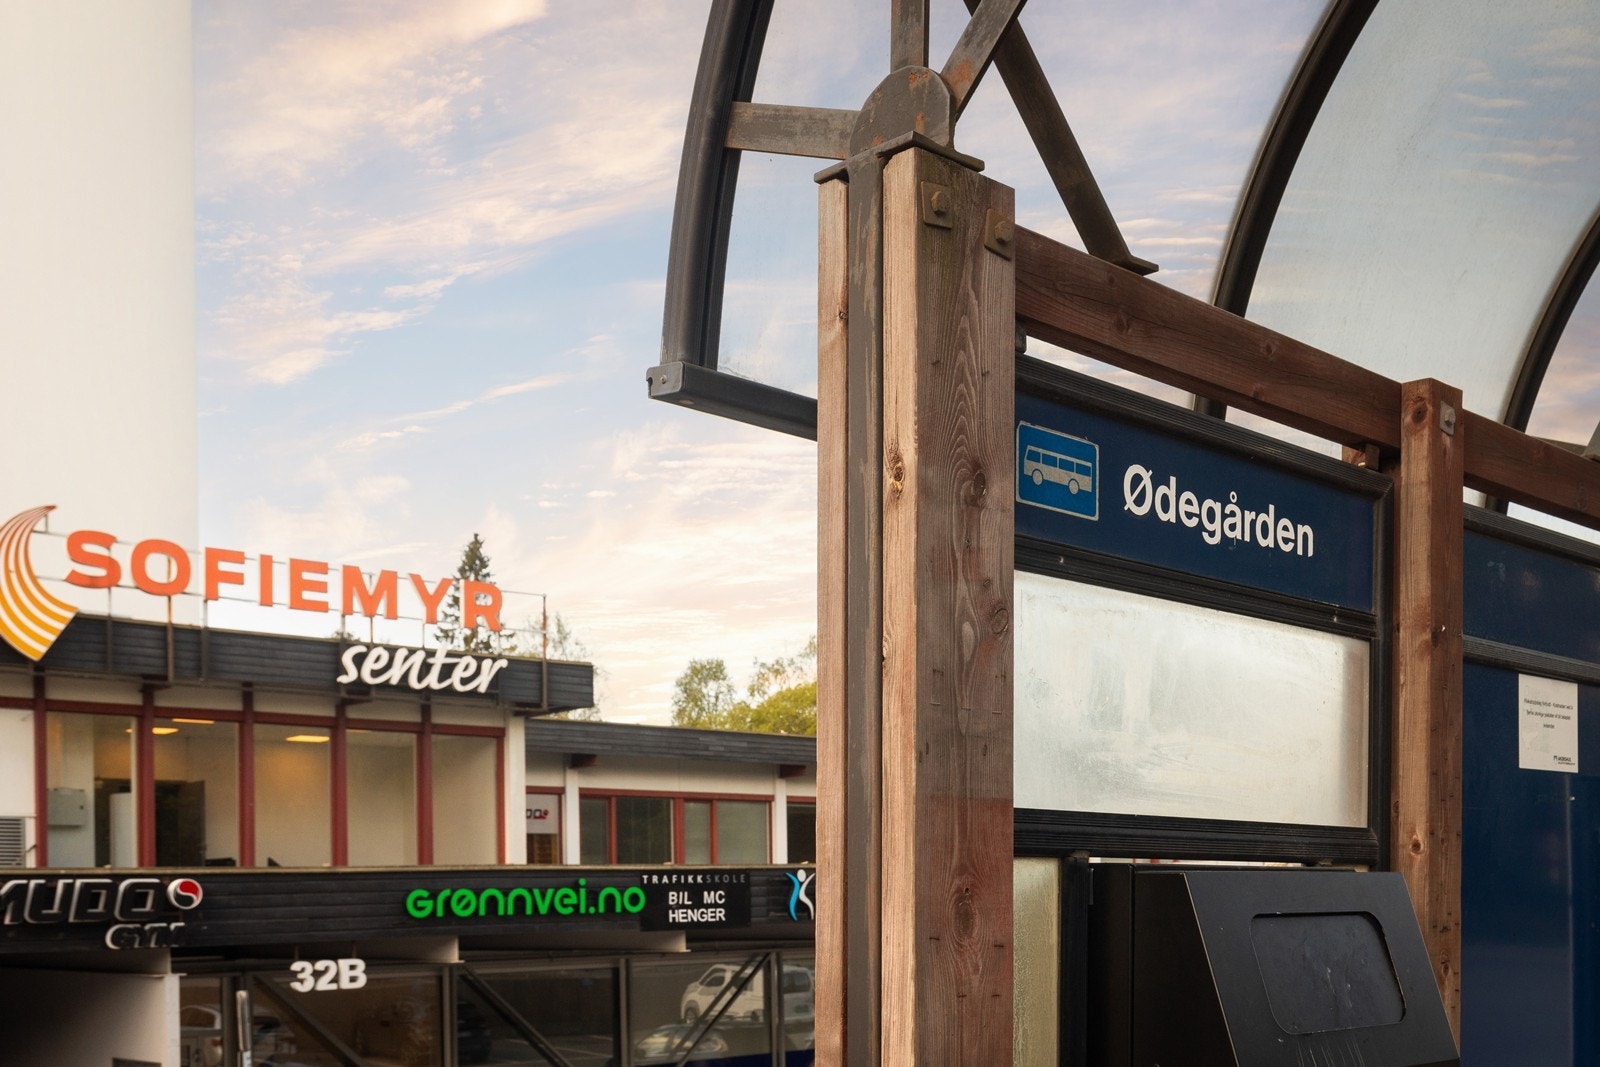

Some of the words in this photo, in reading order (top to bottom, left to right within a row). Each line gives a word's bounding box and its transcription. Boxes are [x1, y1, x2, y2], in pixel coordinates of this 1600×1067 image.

[1122, 463, 1314, 558] Ødegården
[65, 529, 504, 633] SOFIEMYR
[336, 643, 509, 694] senter
[642, 873, 748, 885] TRAFIKKSKOLE
[668, 890, 693, 906] BIL
[703, 890, 726, 905] MC
[668, 907, 726, 923] HENGER
[289, 957, 368, 993] 32B
